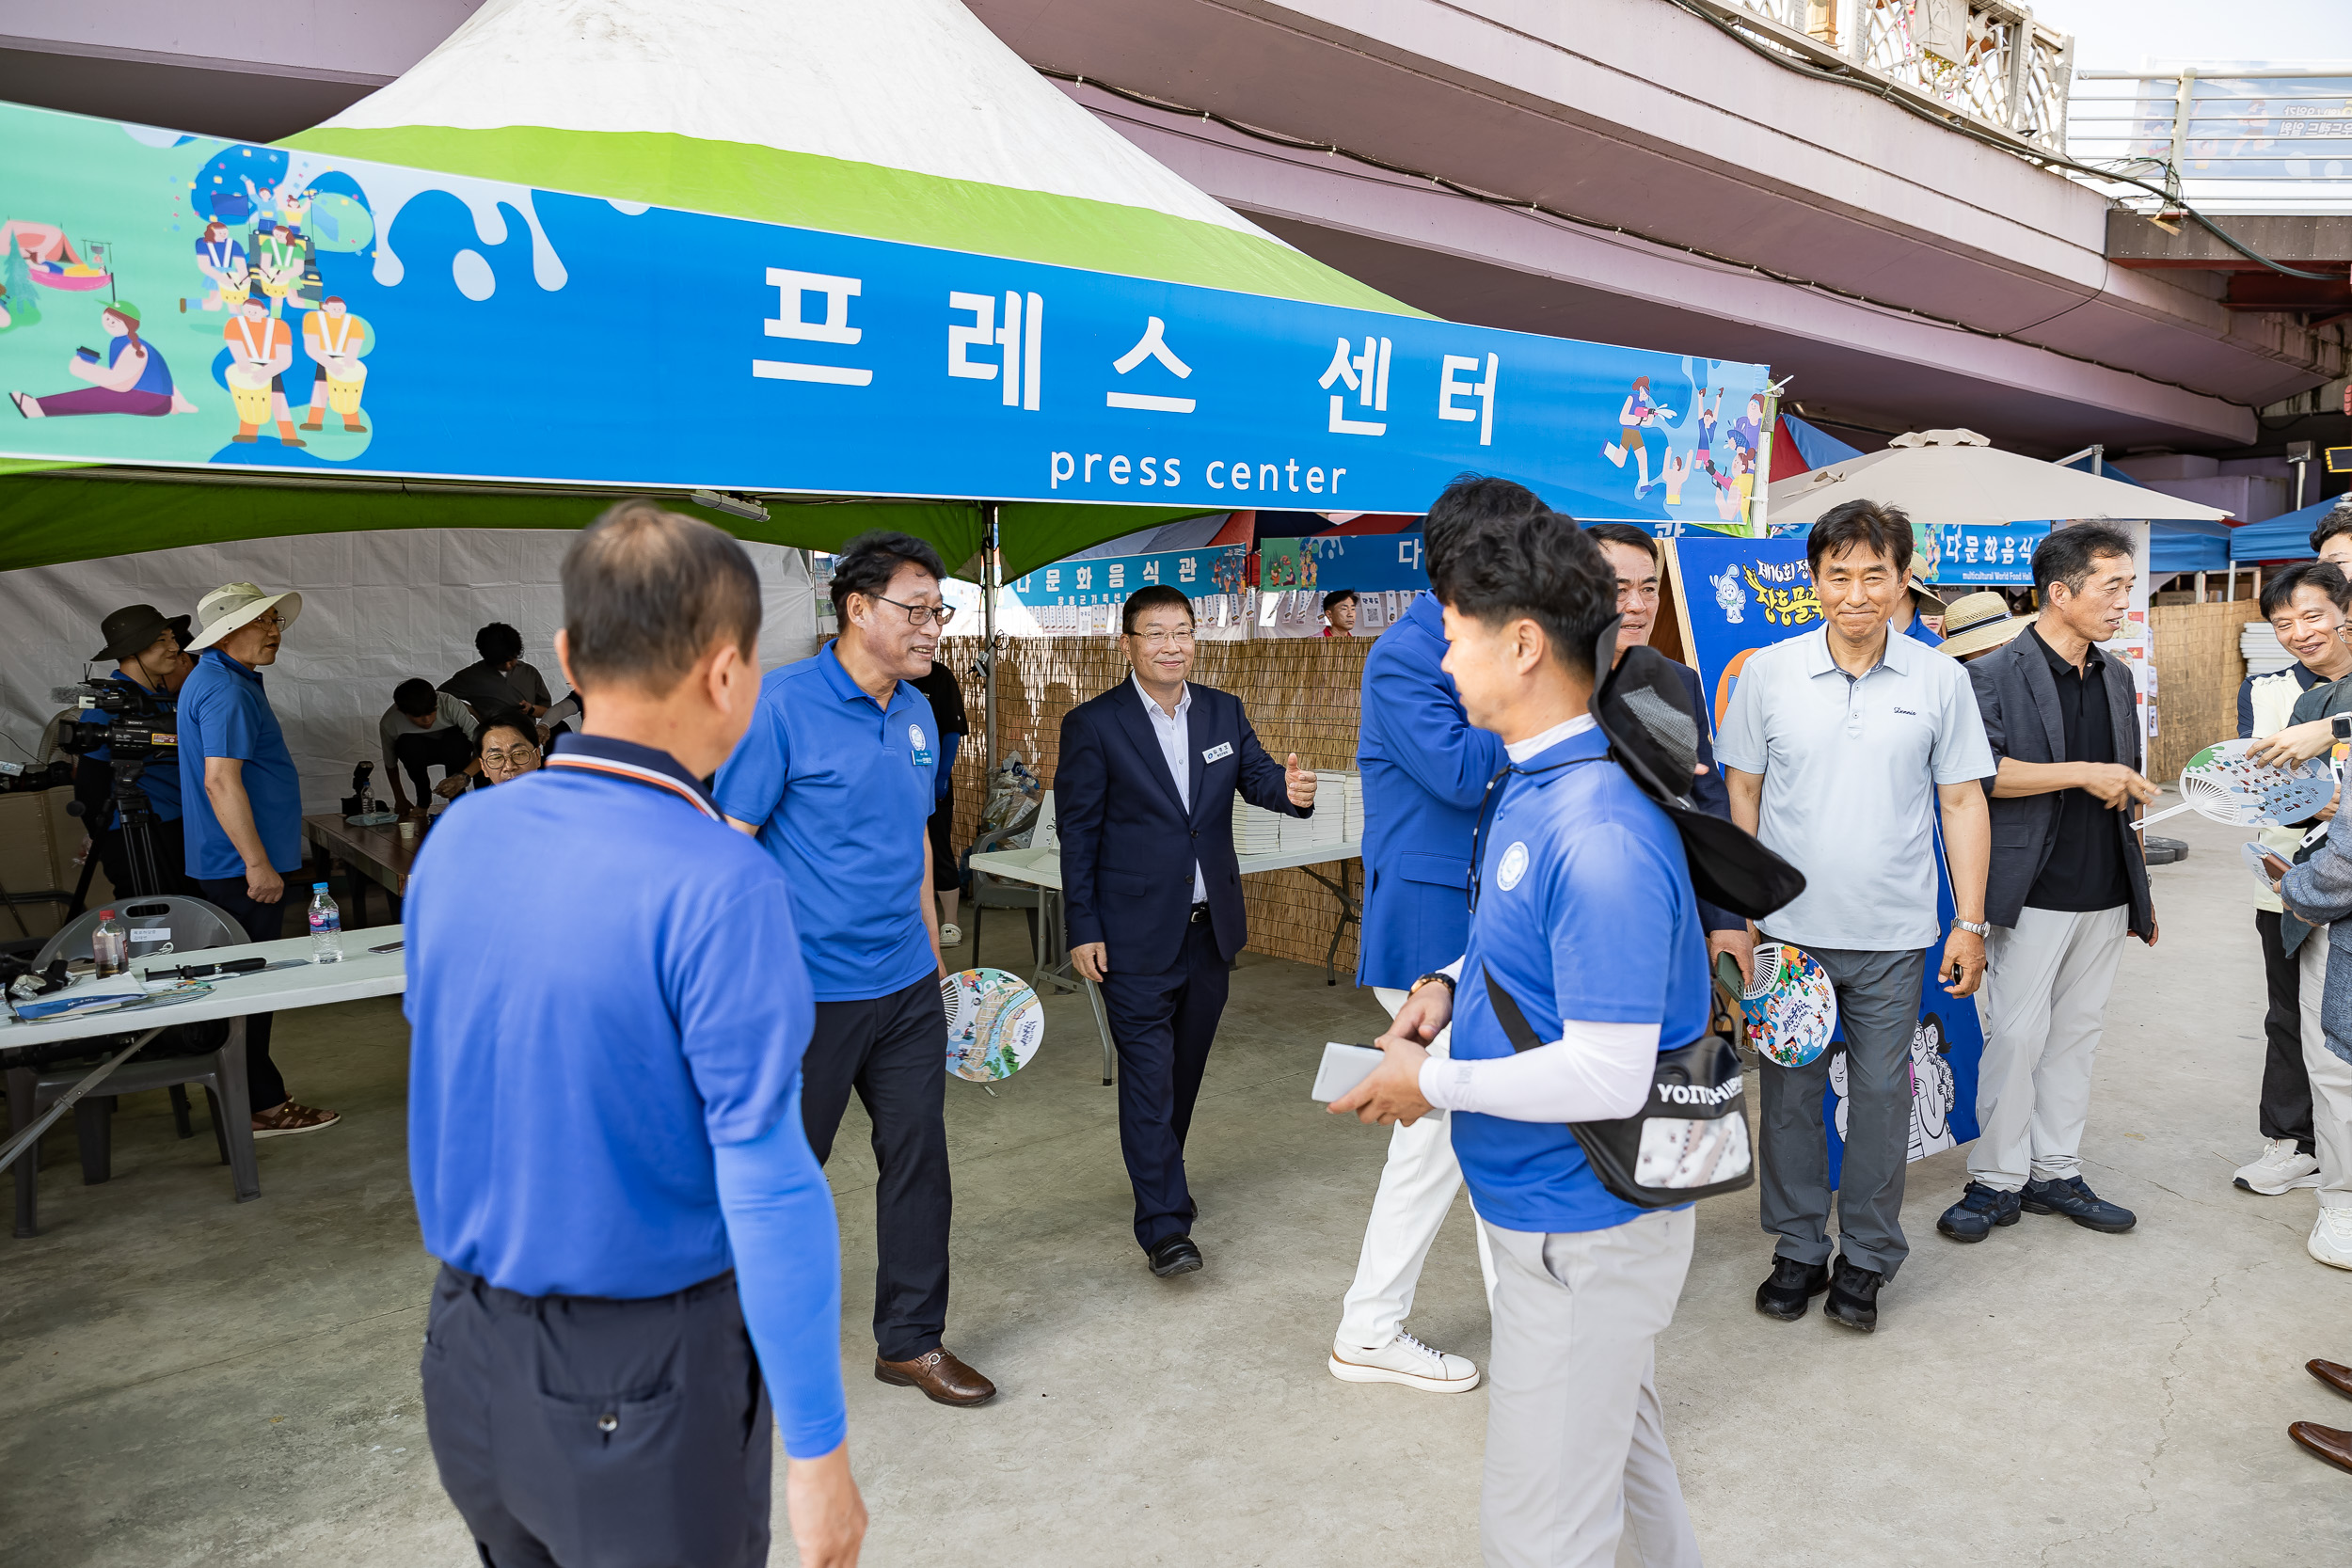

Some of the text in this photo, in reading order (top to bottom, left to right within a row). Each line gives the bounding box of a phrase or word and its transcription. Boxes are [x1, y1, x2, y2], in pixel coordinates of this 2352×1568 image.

[753, 267, 1499, 446] 프레스 센터
[1051, 451, 1346, 494] press center
[1946, 533, 2044, 565] 다문화음식
[1994, 571, 2009, 581] World
[2010, 572, 2022, 581] Food
